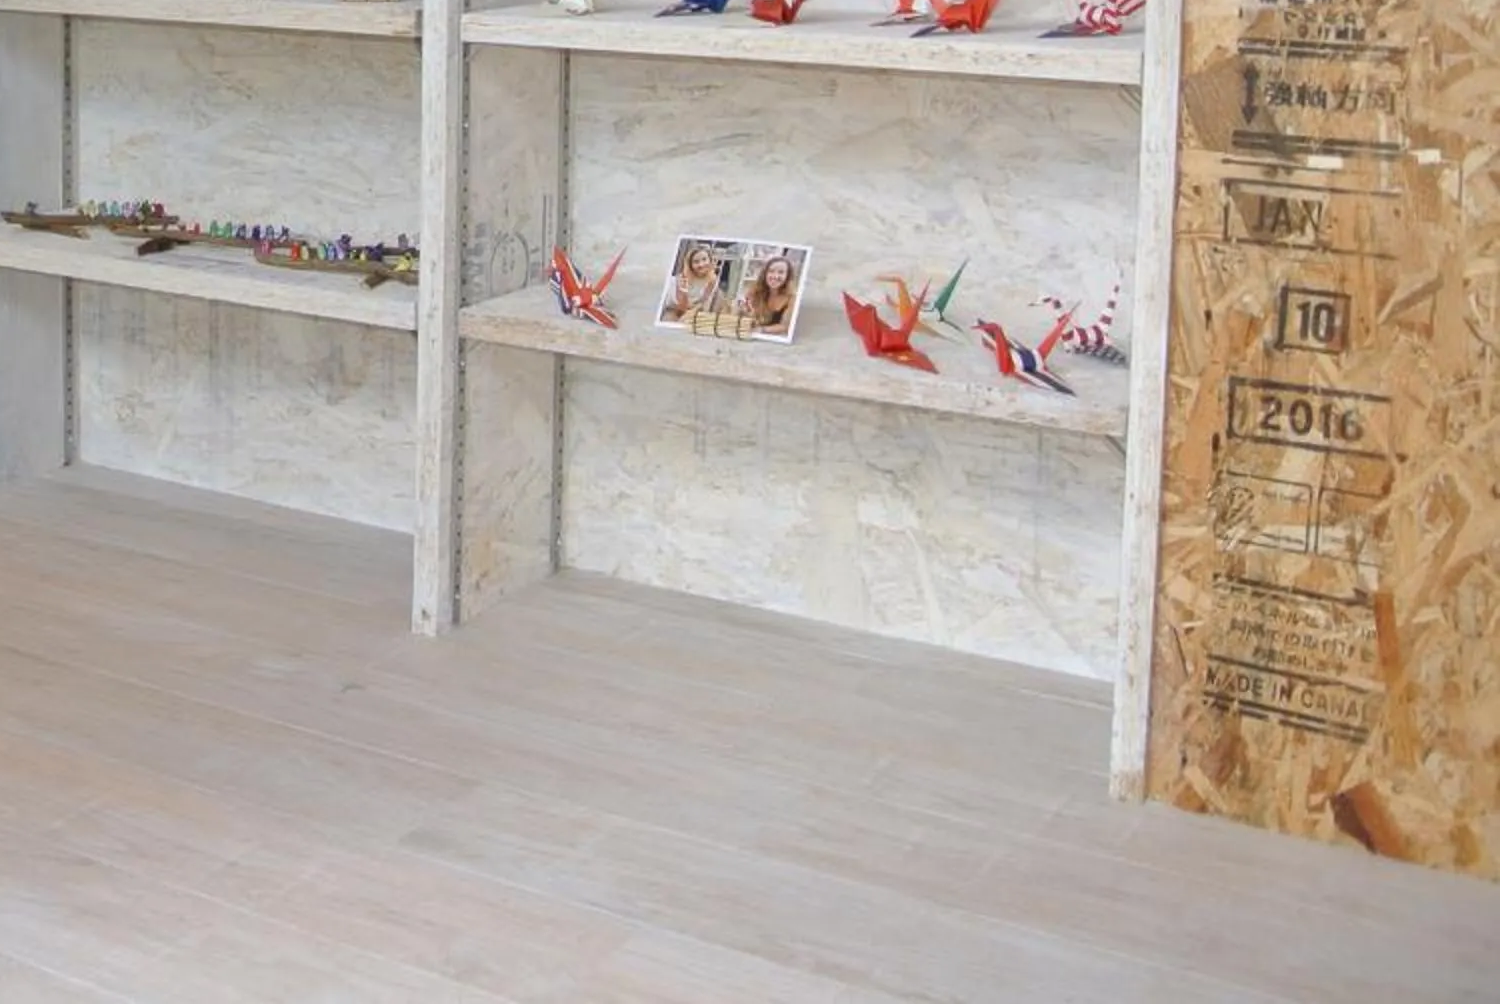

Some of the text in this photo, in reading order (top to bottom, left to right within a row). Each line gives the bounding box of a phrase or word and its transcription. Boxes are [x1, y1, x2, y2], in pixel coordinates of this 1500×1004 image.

[1297, 300, 1336, 345] 10
[1259, 396, 1364, 442] 2016
[1272, 680, 1294, 703] IN
